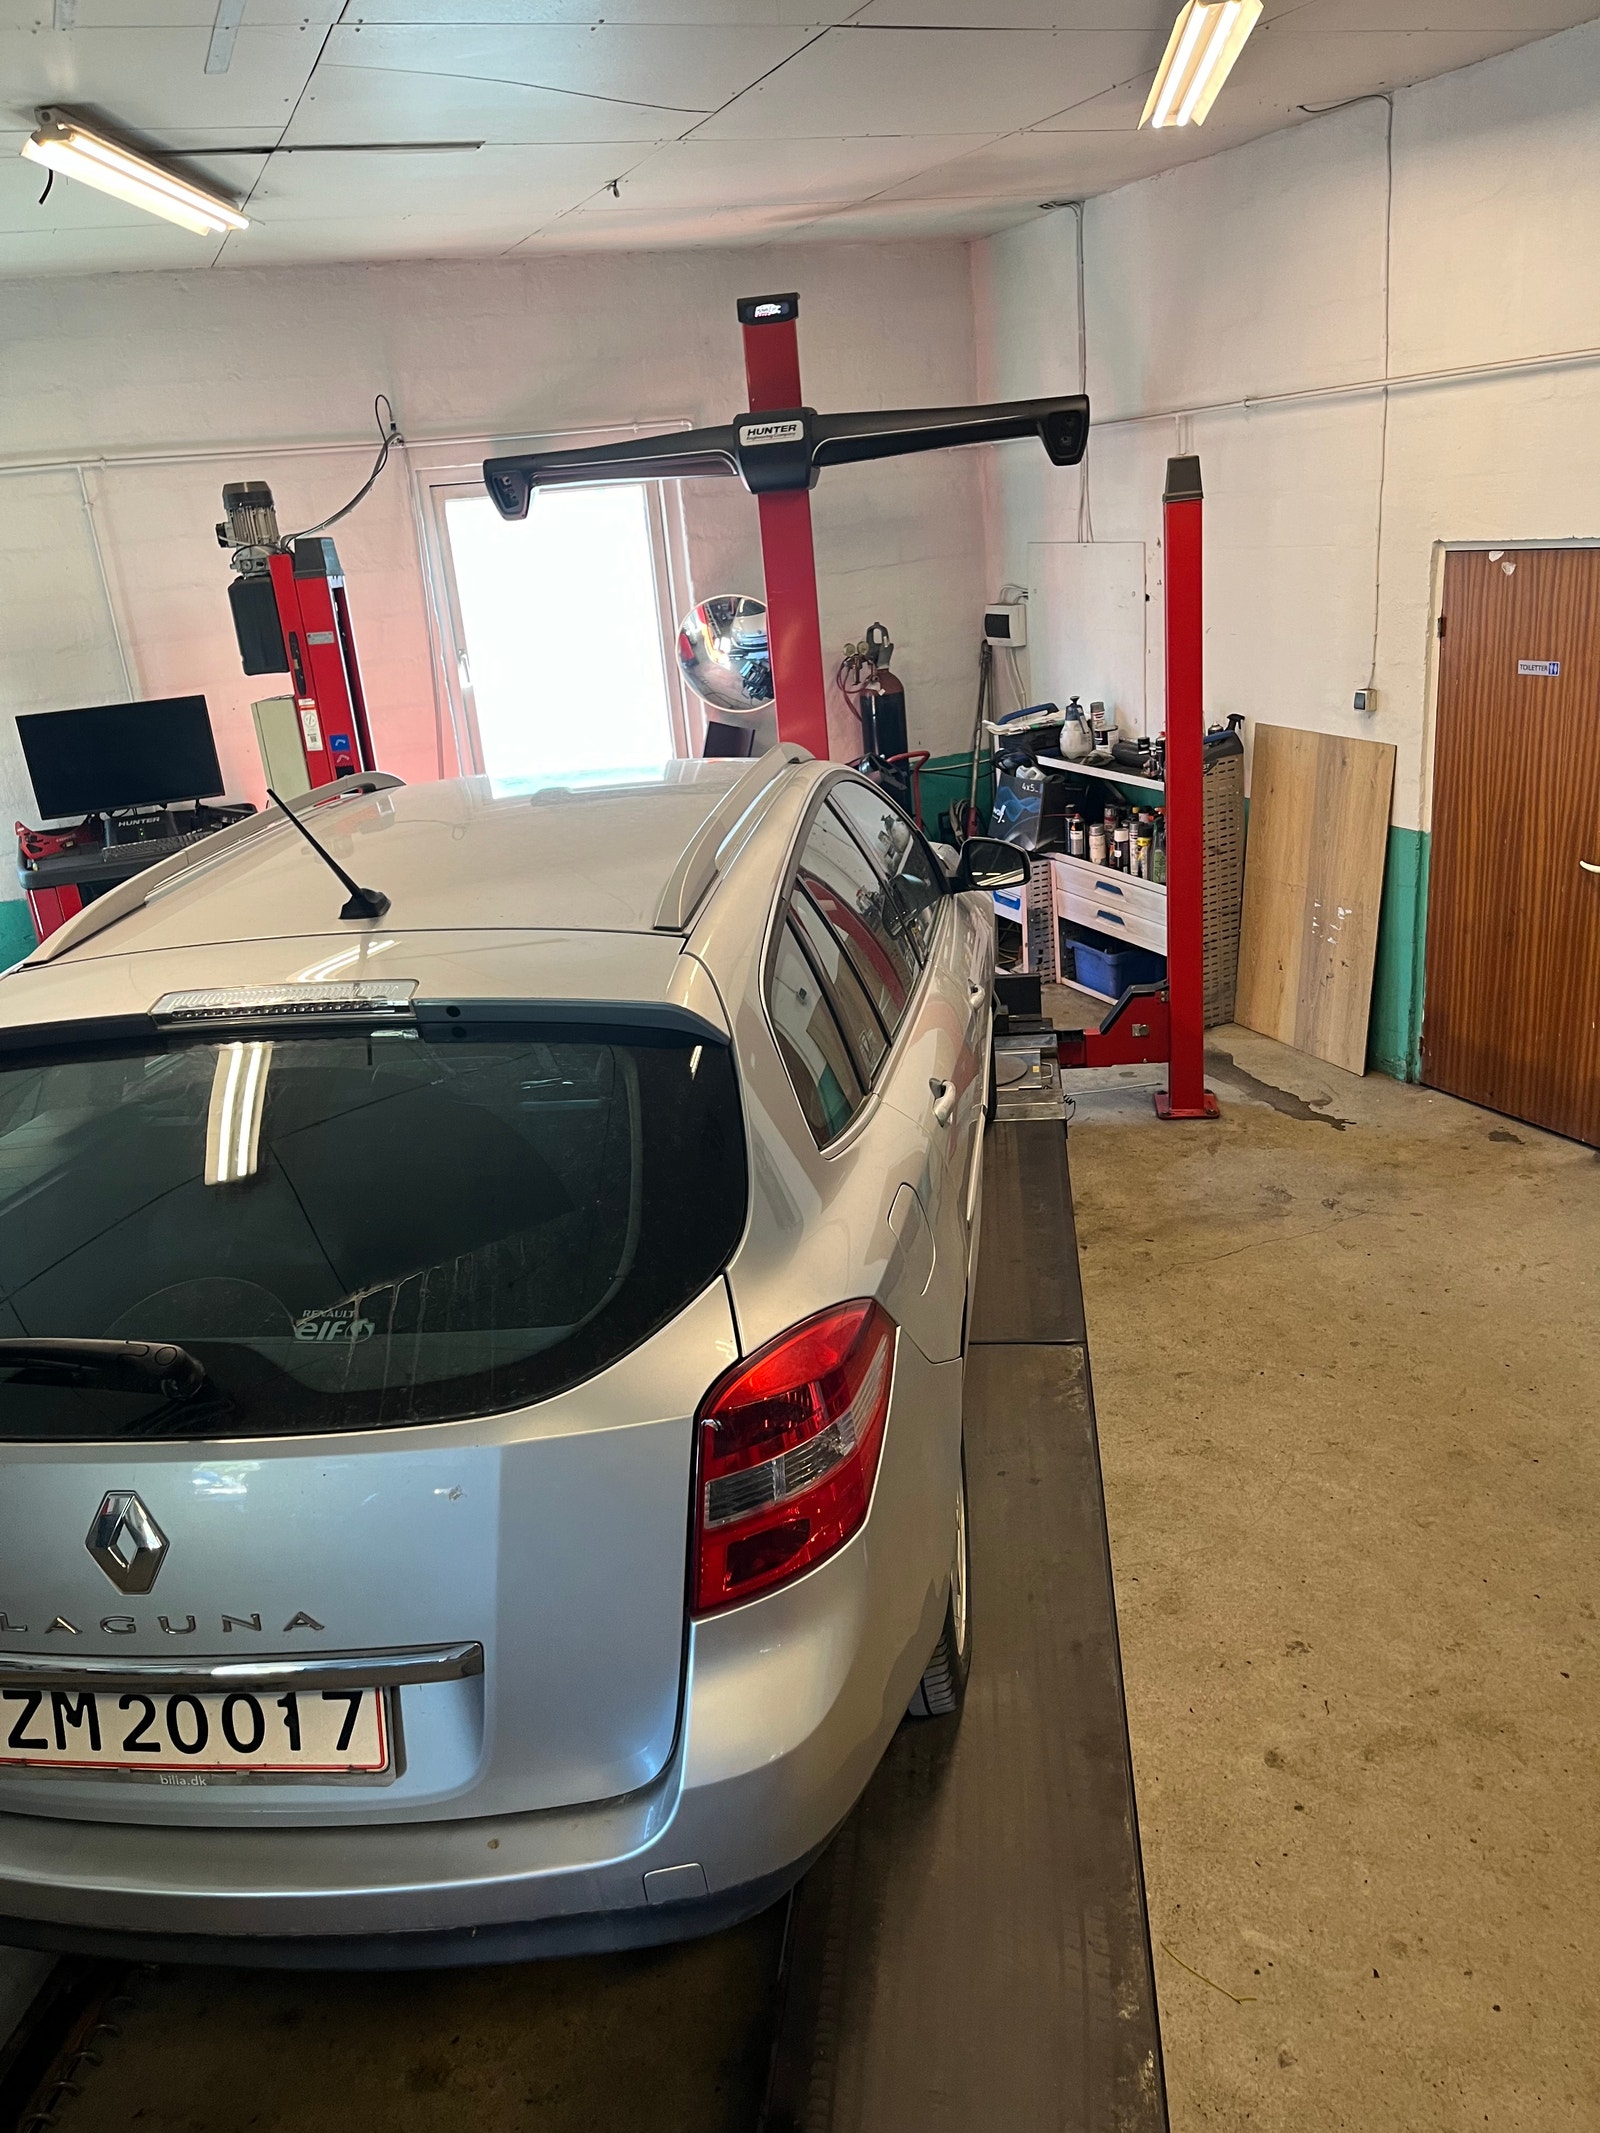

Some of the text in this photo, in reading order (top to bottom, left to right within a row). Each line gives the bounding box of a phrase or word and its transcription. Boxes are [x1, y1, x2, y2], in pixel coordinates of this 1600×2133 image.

[747, 424, 797, 436] HUNTER
[1519, 663, 1548, 672] TOILETTER
[118, 816, 160, 827] HUNTER
[302, 1309, 354, 1318] RENAULT
[295, 1321, 347, 1341] elf
[0, 1611, 325, 1634] LAGUNA
[160, 1774, 207, 1786] bilia.dk
